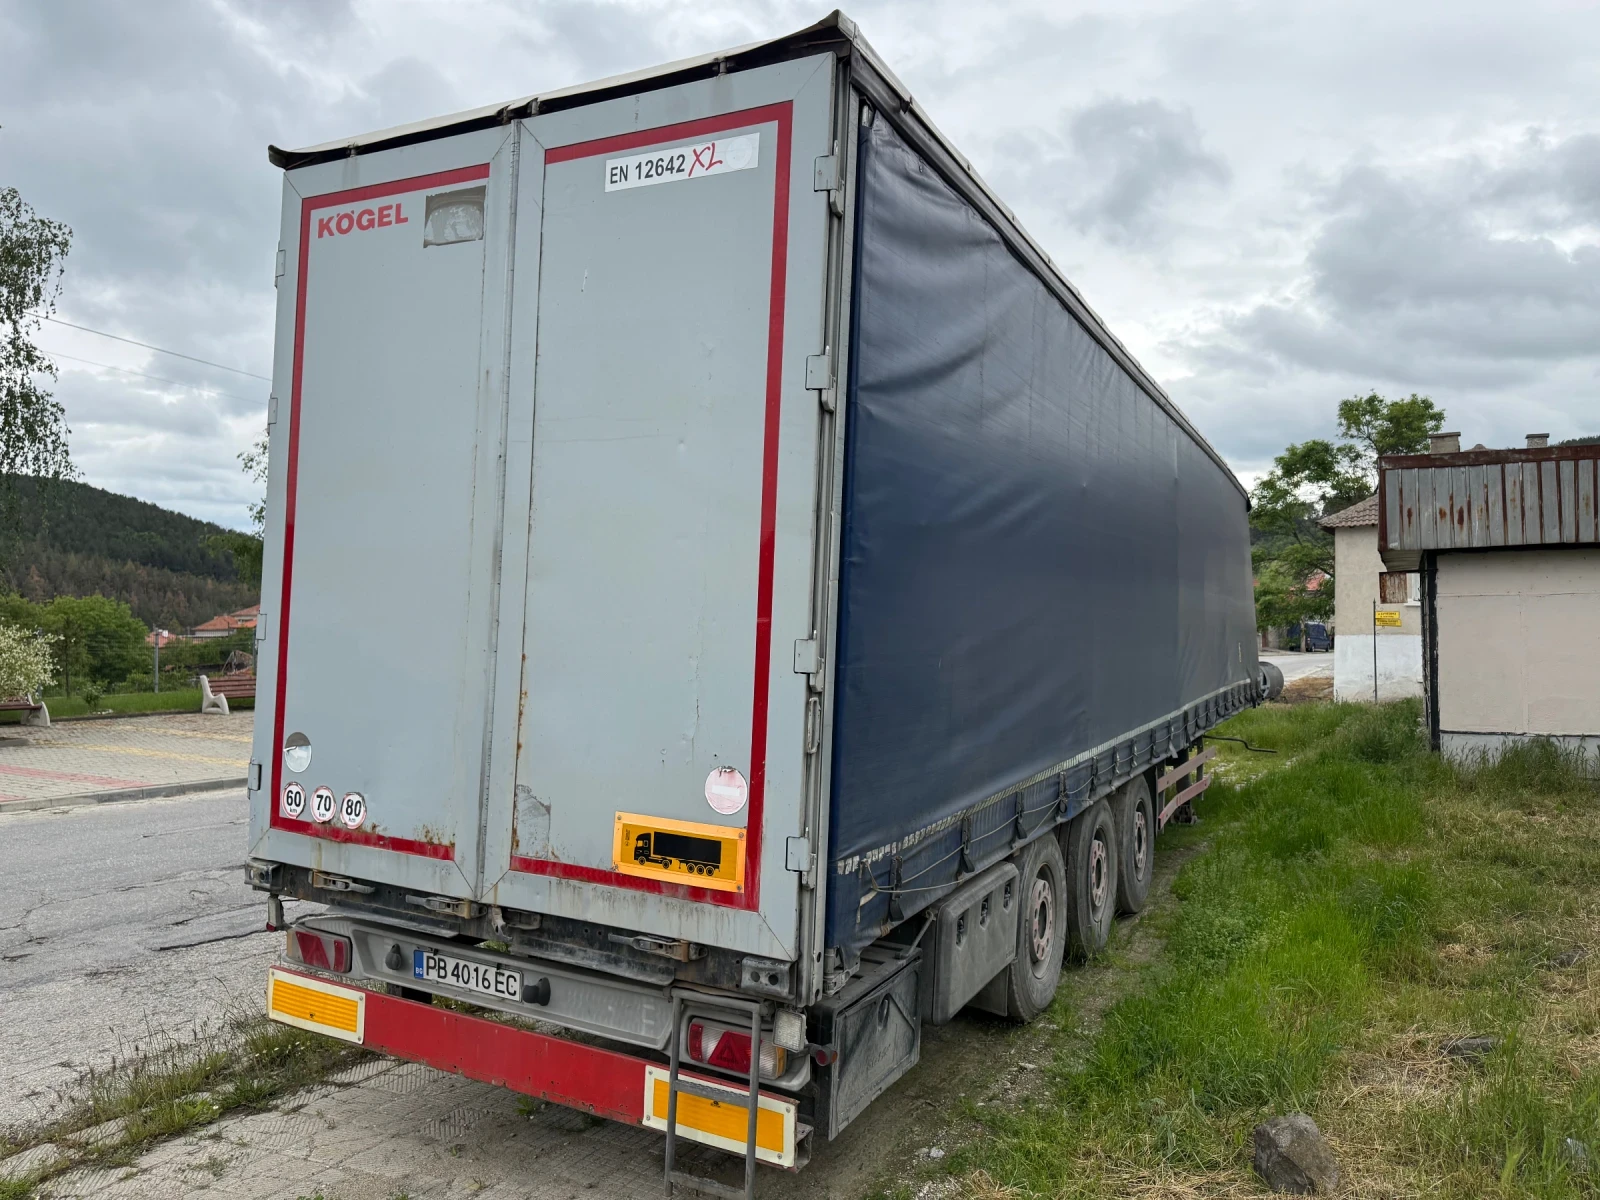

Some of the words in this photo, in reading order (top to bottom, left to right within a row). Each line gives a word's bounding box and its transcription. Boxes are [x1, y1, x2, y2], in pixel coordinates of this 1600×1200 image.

[610, 164, 629, 184] EN
[635, 154, 686, 180] 12642
[688, 142, 723, 177] XL
[317, 203, 409, 239] KÖGEL
[286, 790, 302, 807] 60
[316, 794, 332, 812] 70
[345, 799, 362, 817] 80
[415, 967, 423, 975] BG
